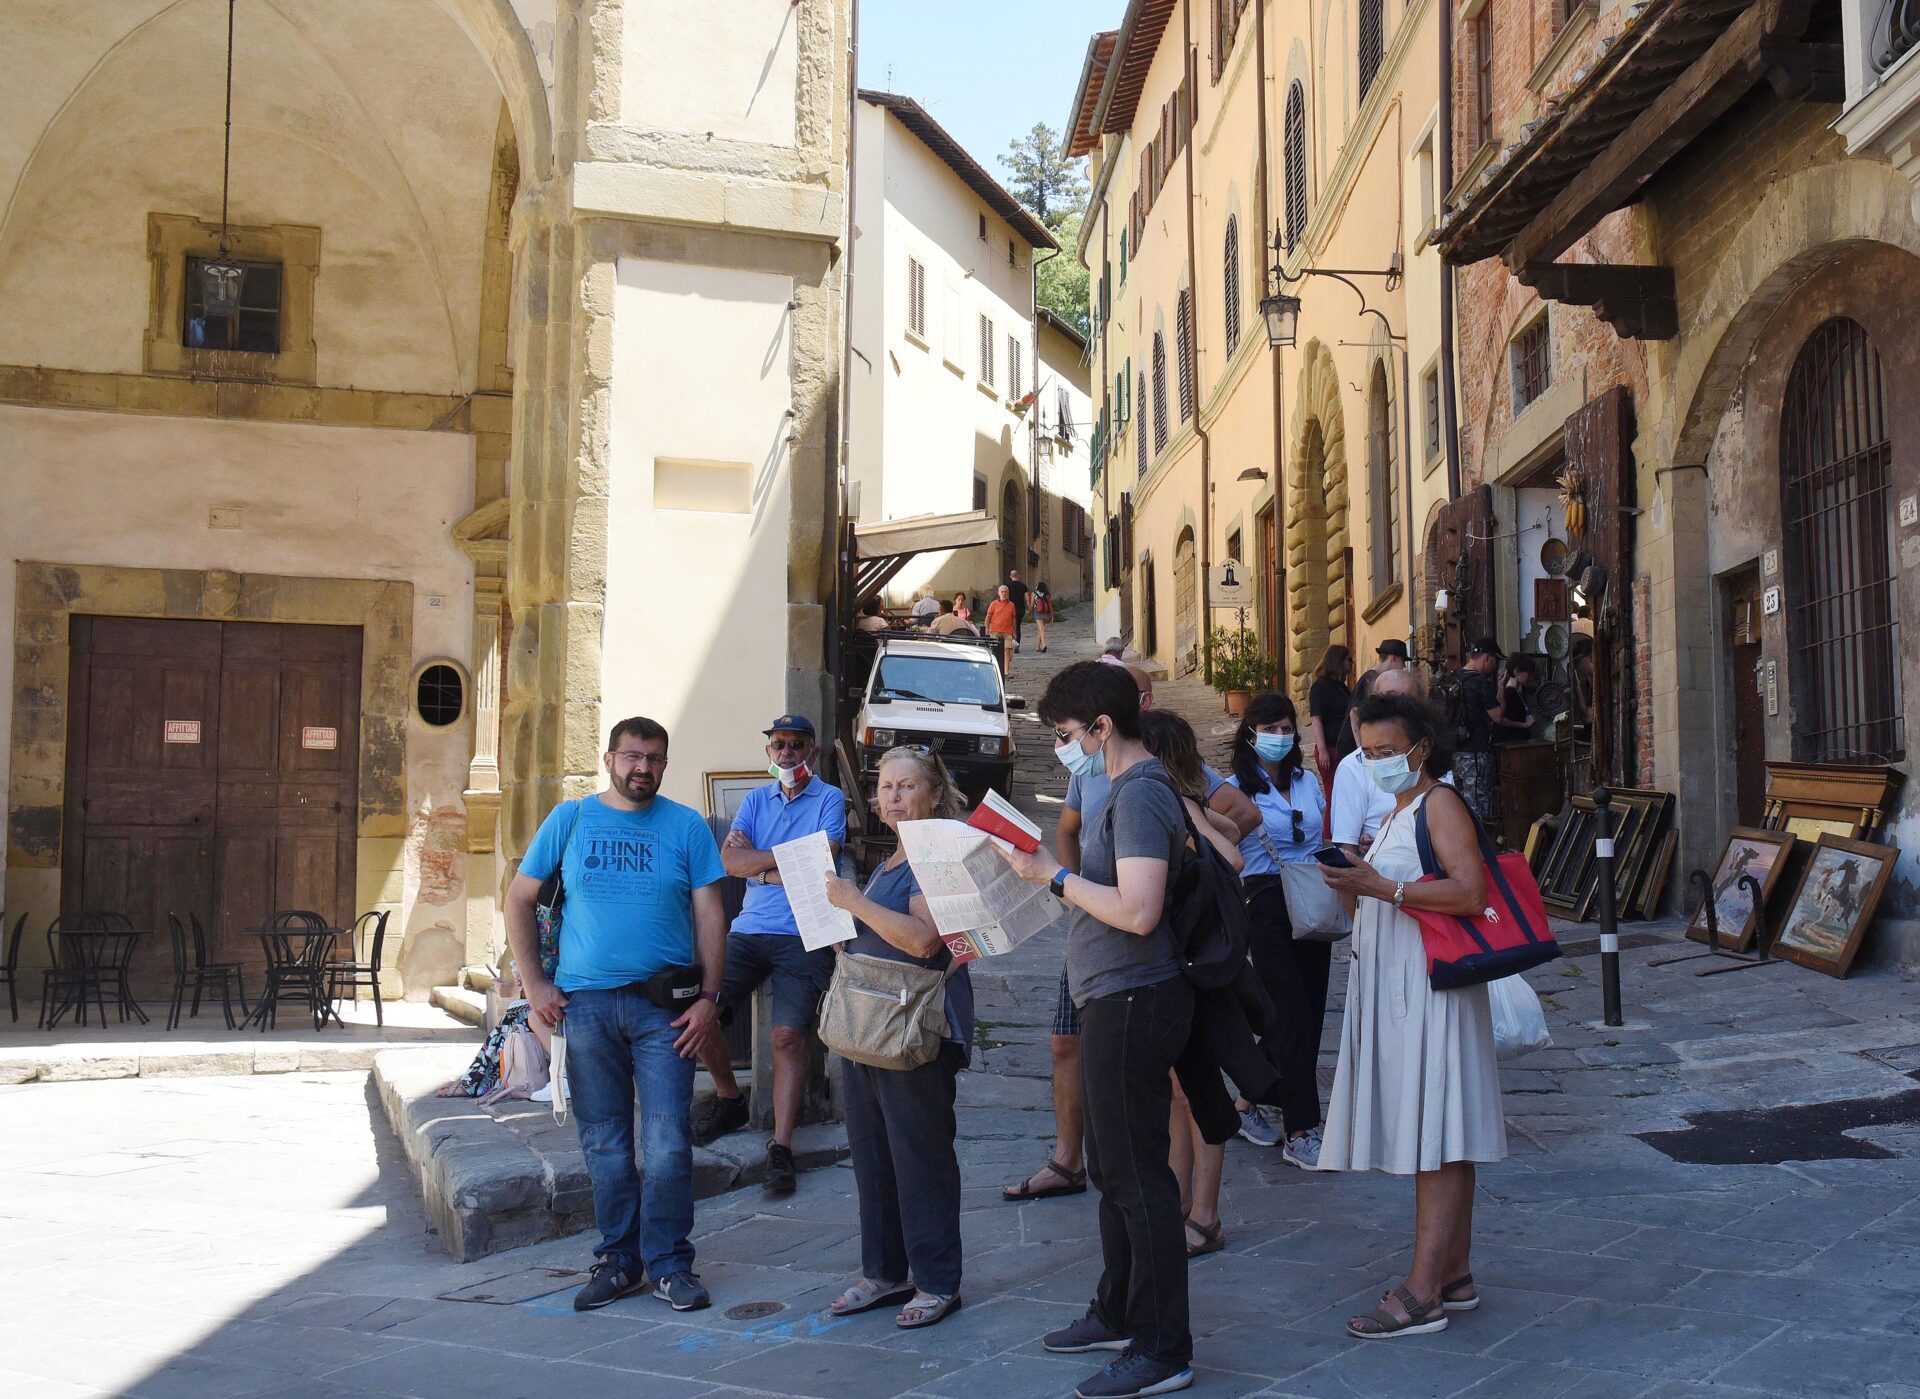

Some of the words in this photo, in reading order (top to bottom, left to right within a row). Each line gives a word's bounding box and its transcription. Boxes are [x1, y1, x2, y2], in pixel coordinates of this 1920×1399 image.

[1903, 502, 1915, 520] 24
[1766, 553, 1776, 571] 23
[430, 598, 440, 606] 22
[1766, 593, 1776, 611] 23
[168, 723, 198, 732] AFFITTASI
[305, 730, 334, 739] AFFITTASI
[587, 840, 654, 858] THINK
[601, 855, 655, 873] PINK
